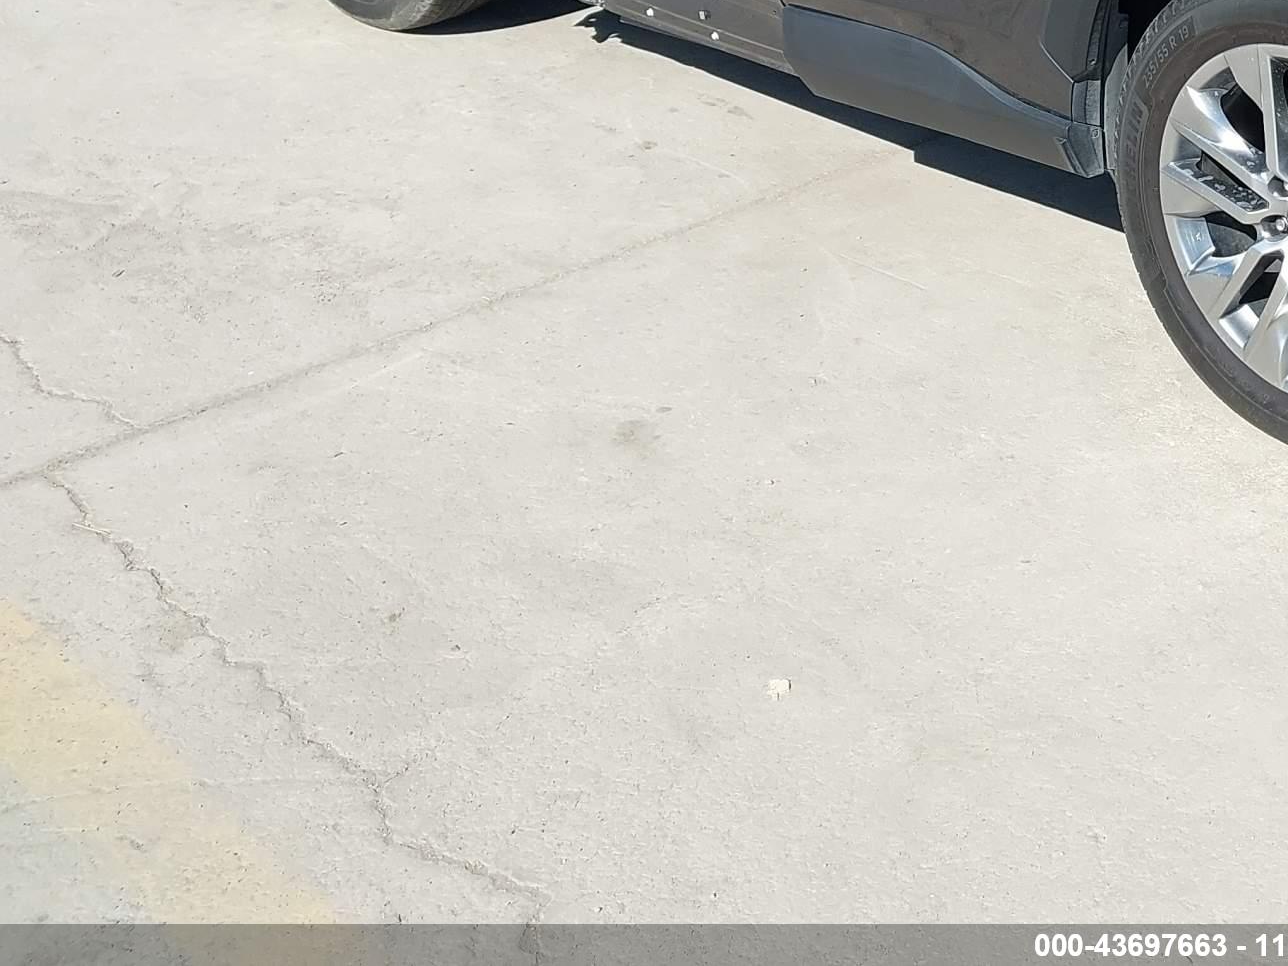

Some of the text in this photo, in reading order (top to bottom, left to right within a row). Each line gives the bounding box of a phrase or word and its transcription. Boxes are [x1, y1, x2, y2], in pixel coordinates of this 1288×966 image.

[1143, 24, 1189, 87] 235/55 R 19
